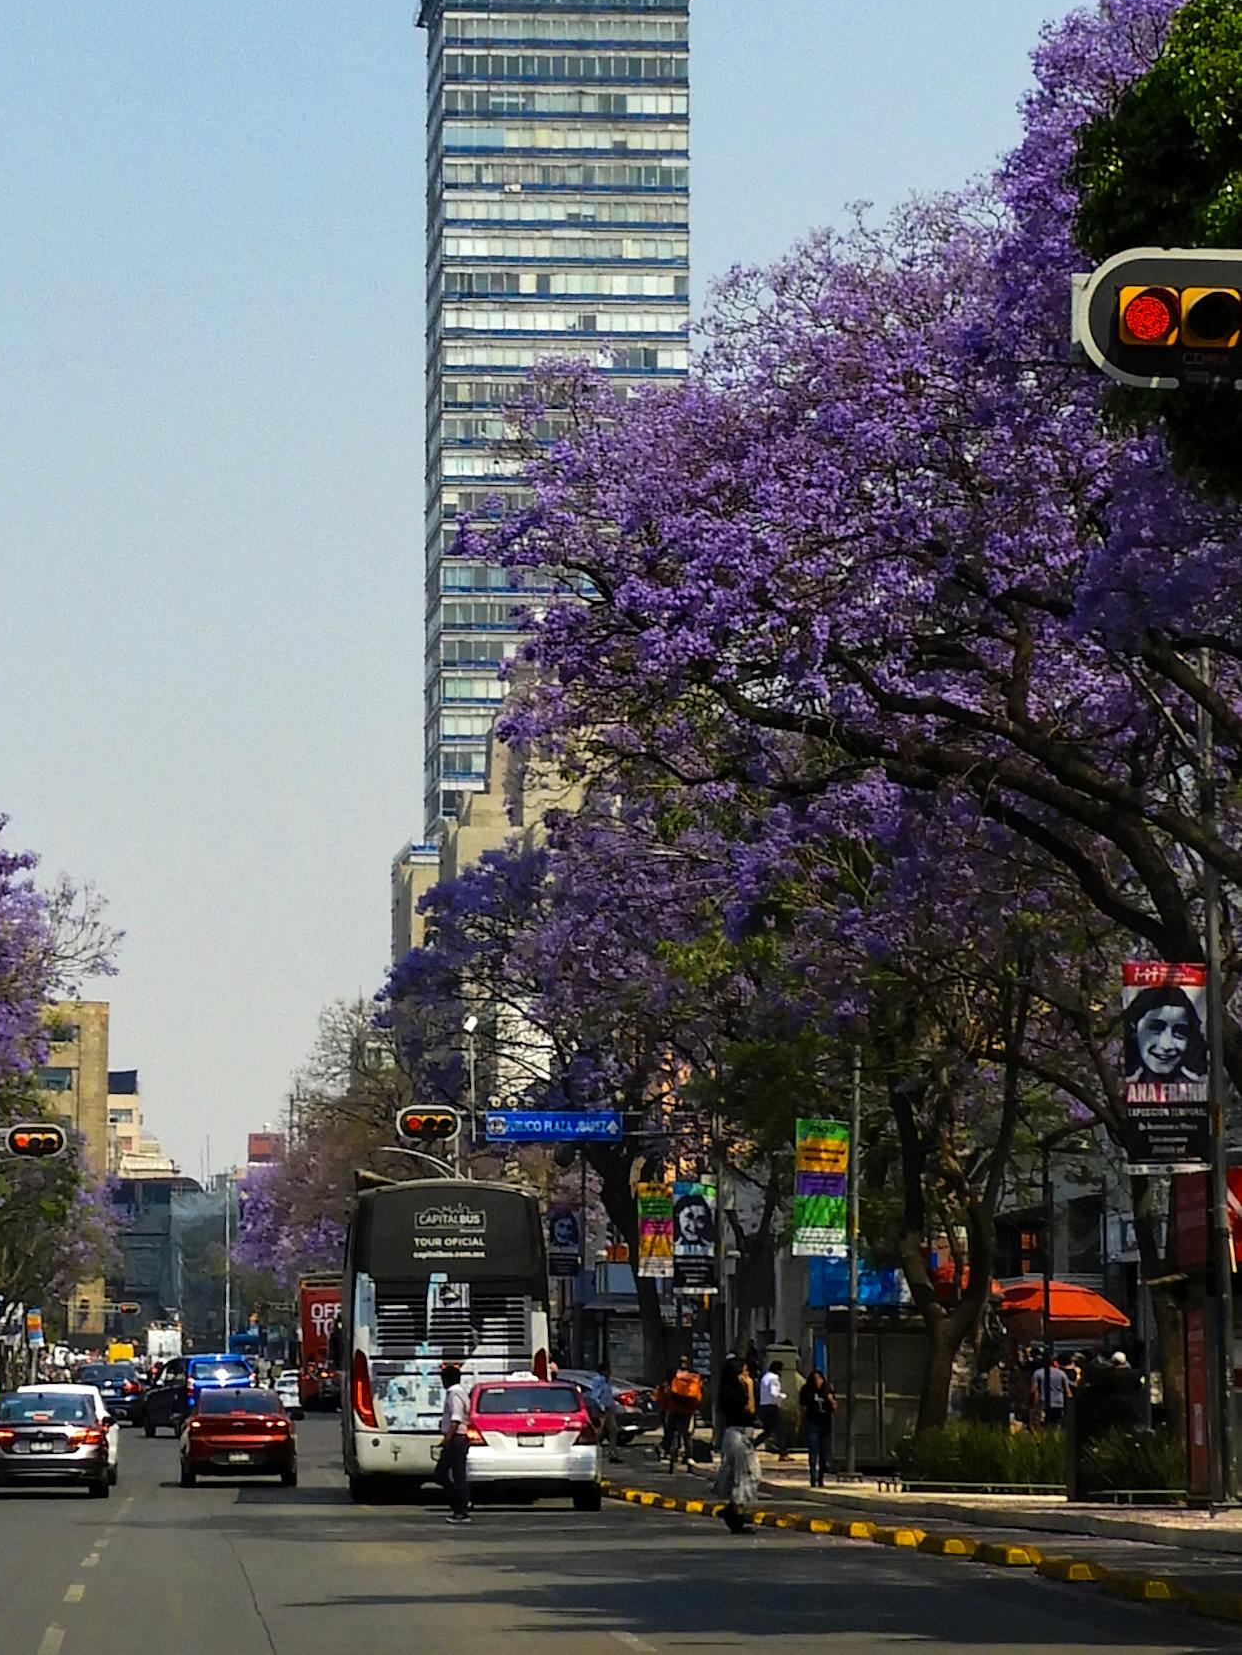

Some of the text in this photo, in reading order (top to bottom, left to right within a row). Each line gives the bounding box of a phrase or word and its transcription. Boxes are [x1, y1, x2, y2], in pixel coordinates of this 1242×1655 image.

[1127, 1082, 1208, 1103] ANA FRANK
[544, 1119, 573, 1133] PLAZA
[414, 1237, 486, 1247] TOUR OFICIAL
